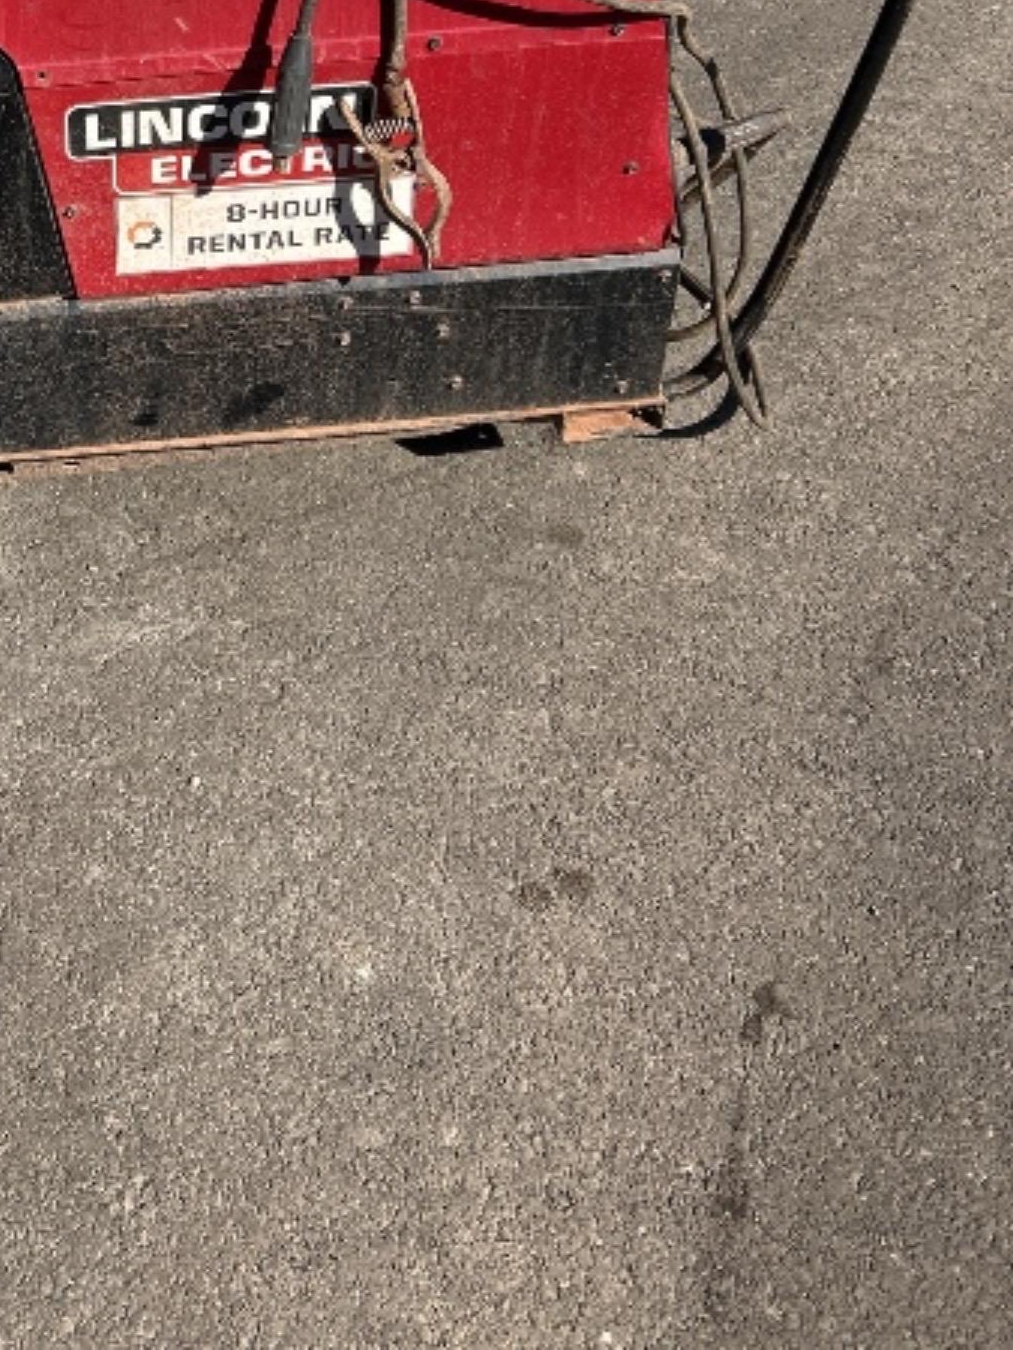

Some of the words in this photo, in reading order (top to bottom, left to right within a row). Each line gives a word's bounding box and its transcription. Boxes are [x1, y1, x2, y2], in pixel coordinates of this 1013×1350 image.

[84, 95, 358, 150] LINCON
[226, 197, 345, 224] 8-HOUR
[188, 229, 303, 256] RENTAL
[315, 224, 390, 247] RATE
